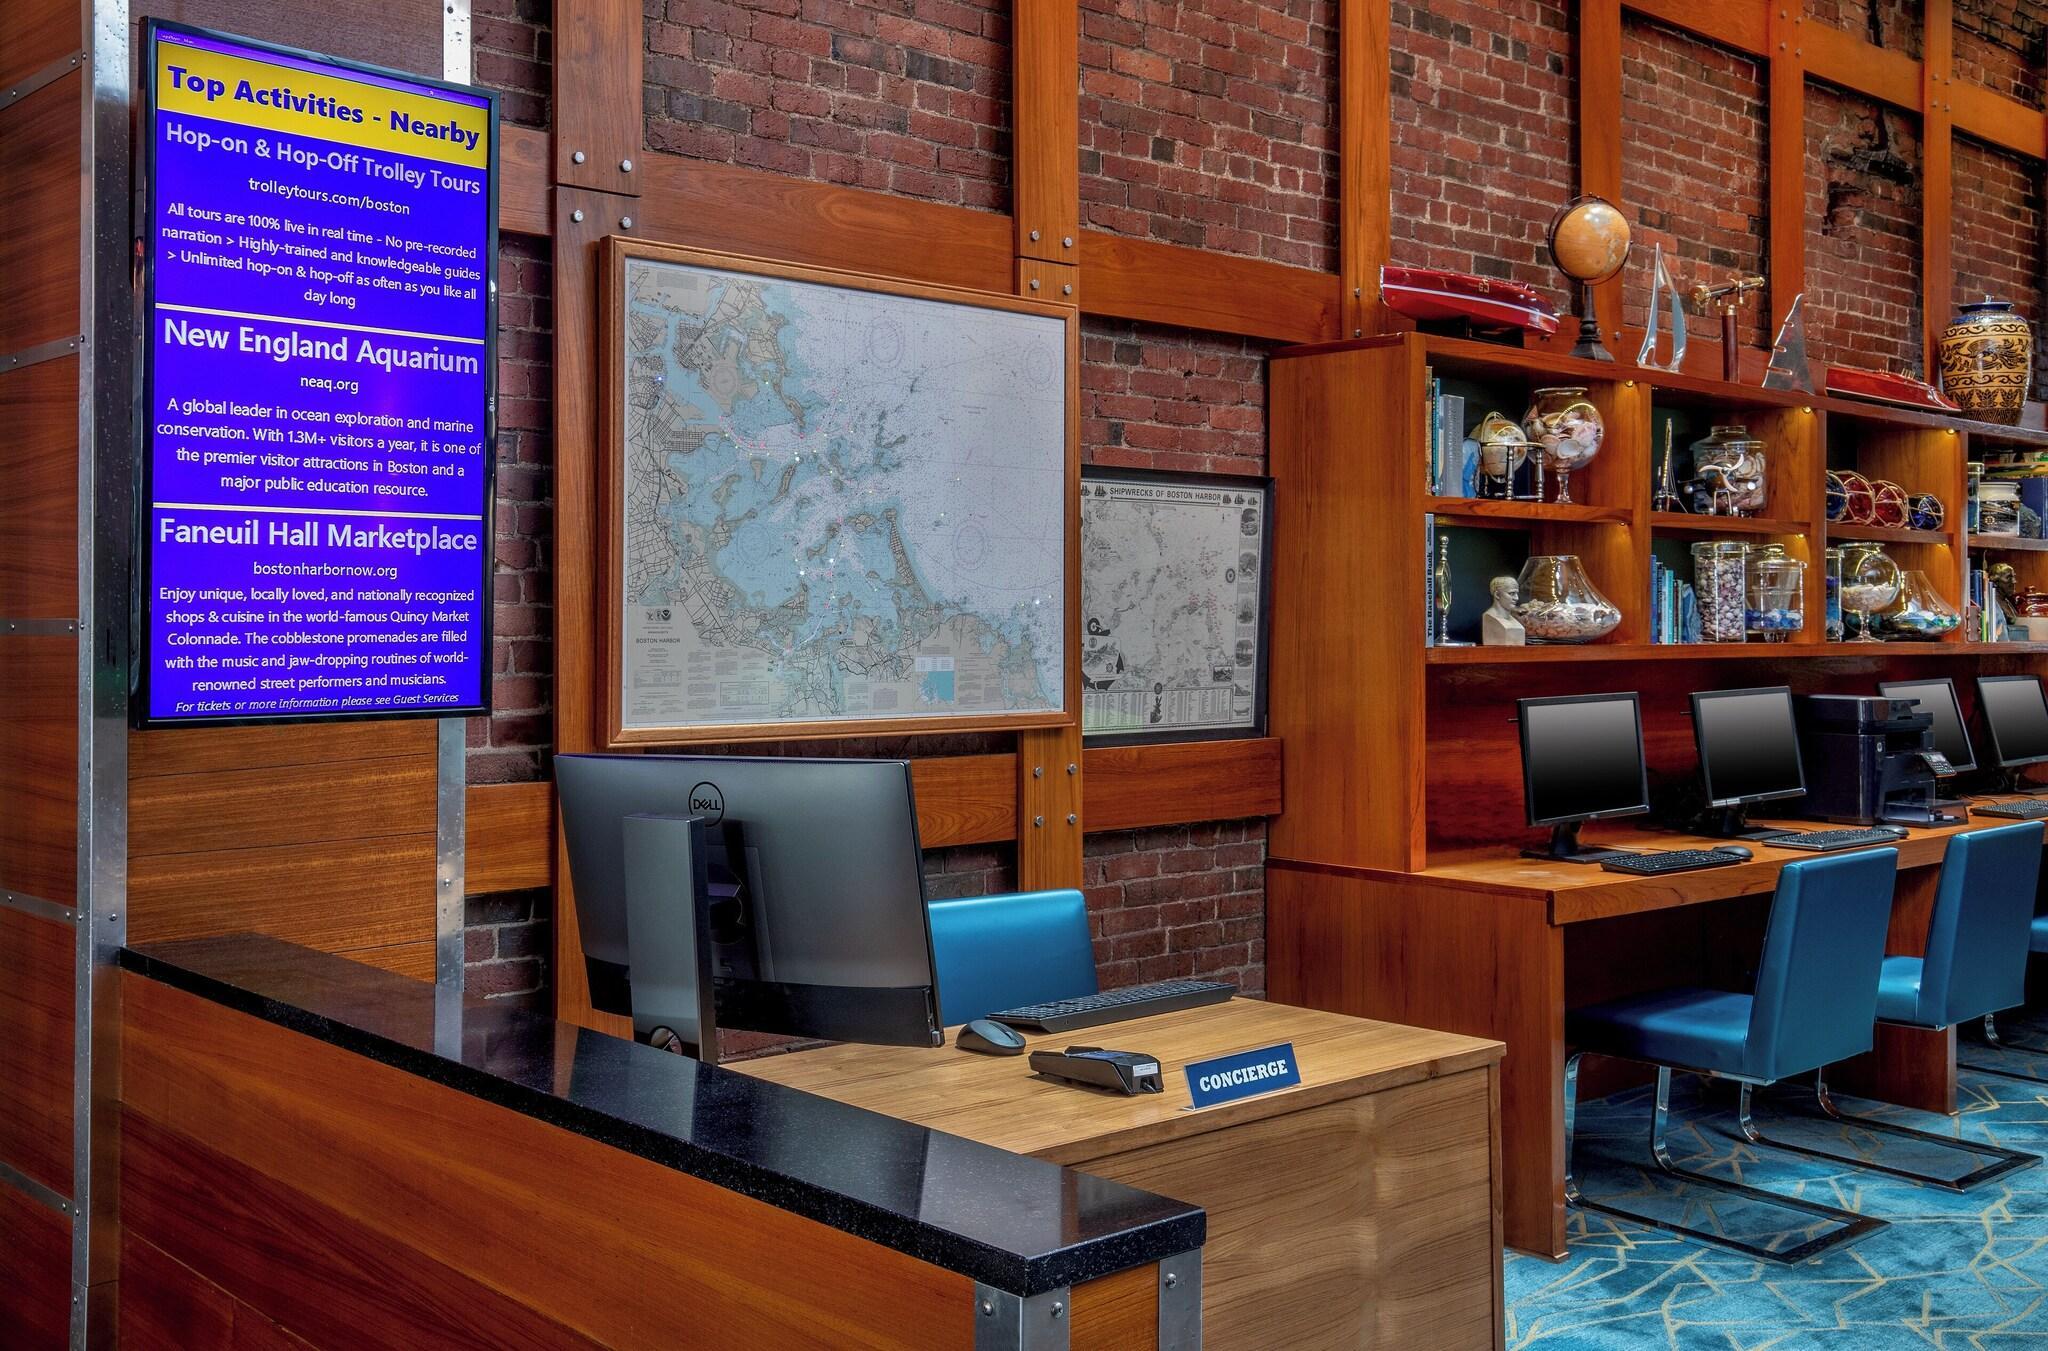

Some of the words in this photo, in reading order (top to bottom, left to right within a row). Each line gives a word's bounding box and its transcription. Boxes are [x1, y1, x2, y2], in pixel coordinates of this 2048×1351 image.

[167, 65, 225, 101] Top
[234, 80, 363, 123] Activities
[391, 111, 479, 150] Nearby
[167, 122, 248, 154] Hop-on
[254, 139, 271, 158] &
[277, 142, 359, 173] Hop-Off
[362, 157, 426, 189] Trolley
[430, 170, 480, 194] Tours
[248, 178, 410, 215] trolleytours.com/boston
[167, 203, 184, 216] All
[187, 206, 222, 221] tours
[224, 214, 245, 225] are
[248, 215, 280, 230] 100%
[284, 219, 305, 234] live
[308, 223, 319, 236] in
[322, 227, 344, 239] real
[347, 230, 373, 244] time
[386, 235, 403, 248] No
[405, 241, 476, 259] pre-recorded
[162, 228, 222, 244] narration
[239, 236, 327, 259] Highly-trained
[330, 251, 353, 263] and
[357, 252, 442, 275] knowledgeable
[444, 267, 481, 281] guides
[181, 250, 243, 269] Unlimited
[247, 258, 293, 276] hop-on
[296, 266, 306, 278] &
[310, 266, 354, 284] hop-off
[356, 276, 370, 286] as
[372, 276, 402, 290] often
[404, 283, 418, 292] as
[420, 284, 440, 296] you
[444, 284, 462, 298] like
[464, 288, 476, 299] all
[304, 289, 327, 306] day
[330, 291, 355, 309] long
[165, 318, 230, 349] New
[240, 326, 347, 362] England
[356, 340, 478, 374] Aquarium
[300, 377, 358, 394] neaq.org
[167, 398, 179, 411] A
[182, 398, 226, 415] global
[230, 401, 273, 418] leader
[276, 406, 288, 419] in
[291, 410, 330, 422] ocean
[335, 412, 403, 427] exploration
[407, 417, 430, 430] and
[434, 420, 474, 433] marine
[157, 424, 249, 440] conservation.
[252, 428, 284, 442] With
[288, 431, 326, 444] 1.3M+
[330, 434, 374, 448] visitors
[377, 439, 385, 448] a
[388, 440, 417, 453] year,
[421, 440, 428, 452] it
[432, 440, 440, 452] is
[443, 443, 466, 454] one
[469, 443, 481, 455] of
[176, 447, 200, 462] the
[203, 451, 257, 466] premier
[260, 453, 300, 467] visitor
[303, 457, 369, 471] attractions
[373, 459, 383, 472] in
[388, 460, 428, 474] Boston
[432, 464, 454, 476] and
[457, 467, 464, 476] a
[221, 475, 261, 491] major
[265, 476, 304, 492] public
[307, 478, 369, 494] education
[374, 485, 428, 496] resource.
[1109, 487, 1153, 497] SHIPWRECKS
[1155, 489, 1165, 497] OF
[1166, 490, 1193, 499] BOSTON
[1195, 493, 1221, 501] HARBOR
[160, 518, 259, 544] Faneuil
[269, 521, 318, 546] Hall
[328, 524, 477, 555] Marketplace
[254, 561, 397, 580] bostonharbornow.org
[160, 587, 196, 603] Enjoy
[199, 588, 247, 603] unique,
[251, 587, 289, 603] locally
[292, 588, 328, 602] loved,
[331, 588, 353, 600] and
[358, 589, 413, 604] nationally
[415, 590, 474, 604] recognized
[166, 610, 205, 626] shops
[208, 611, 219, 623] &
[221, 611, 265, 622] cuisine
[268, 611, 280, 622] in
[282, 610, 303, 622] the
[306, 610, 388, 622] world-famous
[390, 611, 429, 625] Quincy
[432, 610, 469, 622] Market
[167, 632, 241, 645] Colonnade.
[244, 632, 269, 644] The
[271, 631, 344, 644] cobblestone
[347, 631, 418, 646] promenades
[420, 634, 438, 642] are
[441, 630, 467, 642] filled
[165, 656, 194, 668] with
[197, 655, 218, 668] the
[222, 655, 259, 667] music
[261, 654, 285, 667] and
[287, 653, 368, 670] jaw-dropping
[371, 653, 417, 664] routines
[419, 651, 432, 663] of
[433, 651, 468, 663] world-
[192, 677, 256, 691] renowned
[260, 678, 295, 689] street
[299, 675, 363, 691] performers
[365, 674, 387, 686] and
[390, 673, 446, 685] musicians.
[176, 702, 195, 712] For
[197, 700, 231, 711] tickets
[234, 702, 247, 710] or
[249, 701, 277, 709] more
[279, 697, 338, 709] Information
[341, 696, 372, 708] please
[375, 697, 391, 705] see
[393, 694, 421, 704] Guest
[423, 693, 459, 703] Services
[693, 799, 721, 810] DELL
[1199, 1059, 1288, 1092] CONCIERGE
